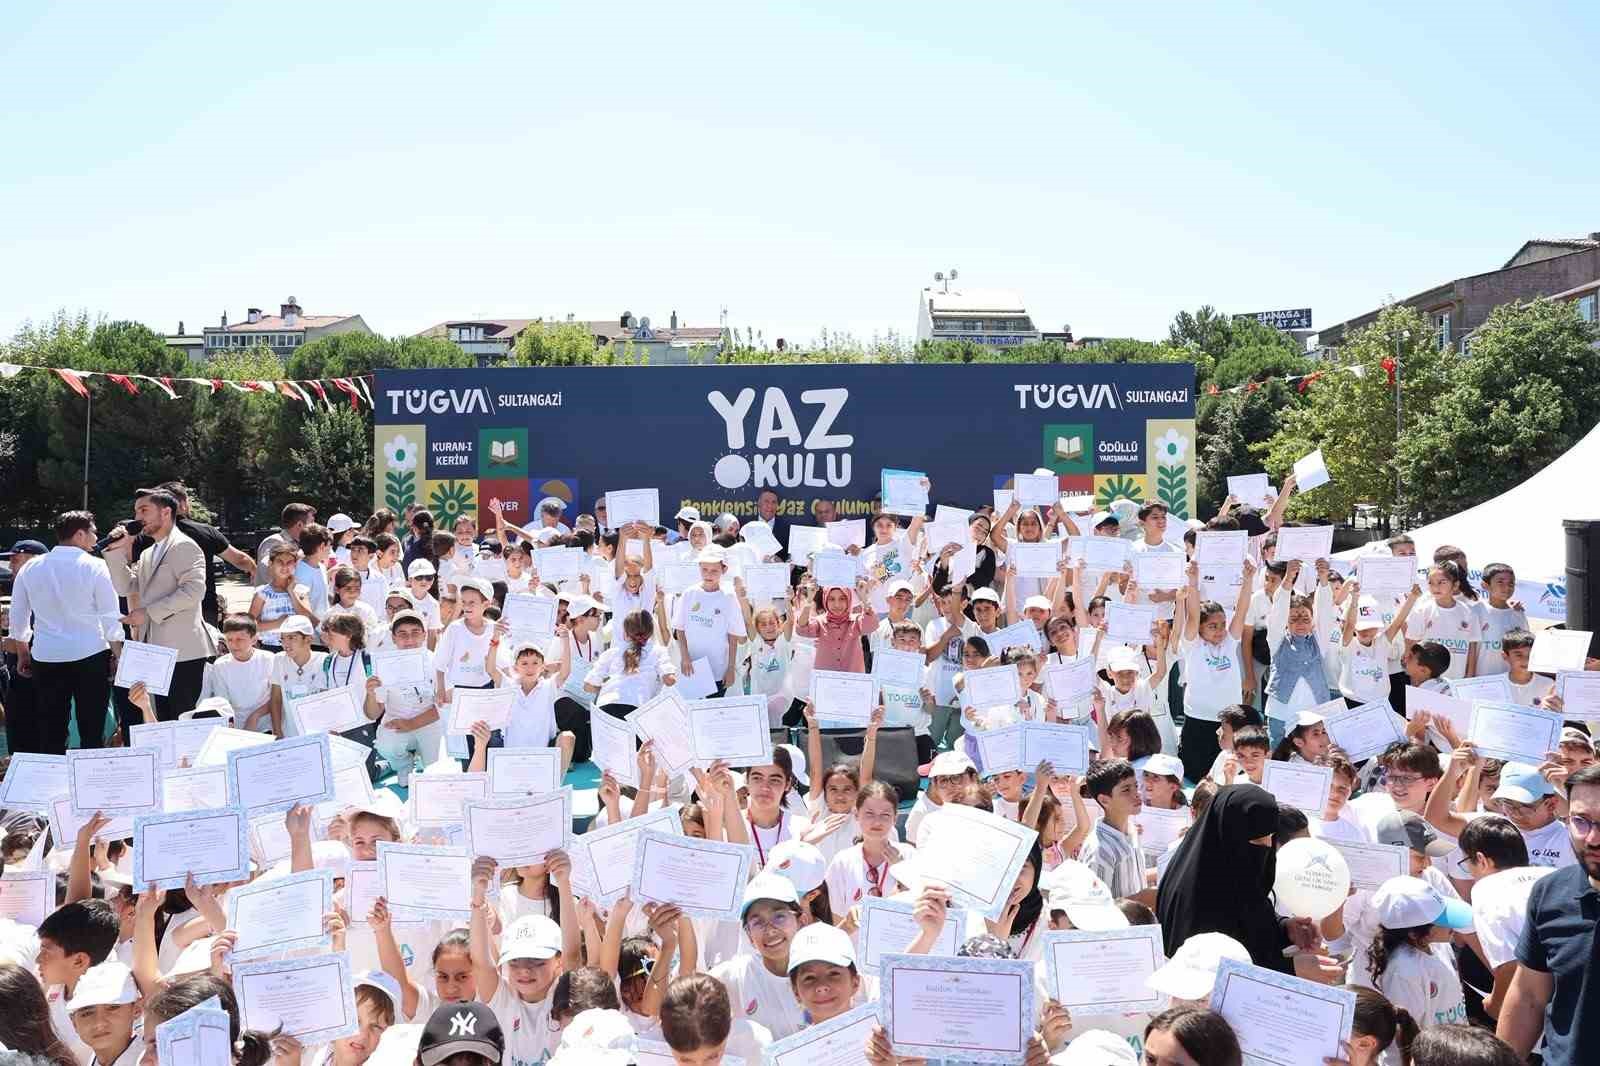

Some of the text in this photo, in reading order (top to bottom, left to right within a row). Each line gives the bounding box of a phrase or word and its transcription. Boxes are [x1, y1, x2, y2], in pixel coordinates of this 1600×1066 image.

[386, 388, 562, 415] TÜGVA SULTANGAZİ
[1014, 384, 1188, 409] TÜGVA SULTANGAZİ
[707, 386, 854, 450] YAZ
[432, 442, 473, 452] KURAN-I
[1098, 441, 1138, 453] ÖDÜLLÜ
[435, 454, 469, 466] KERİM
[448, 1011, 478, 1036] NY
